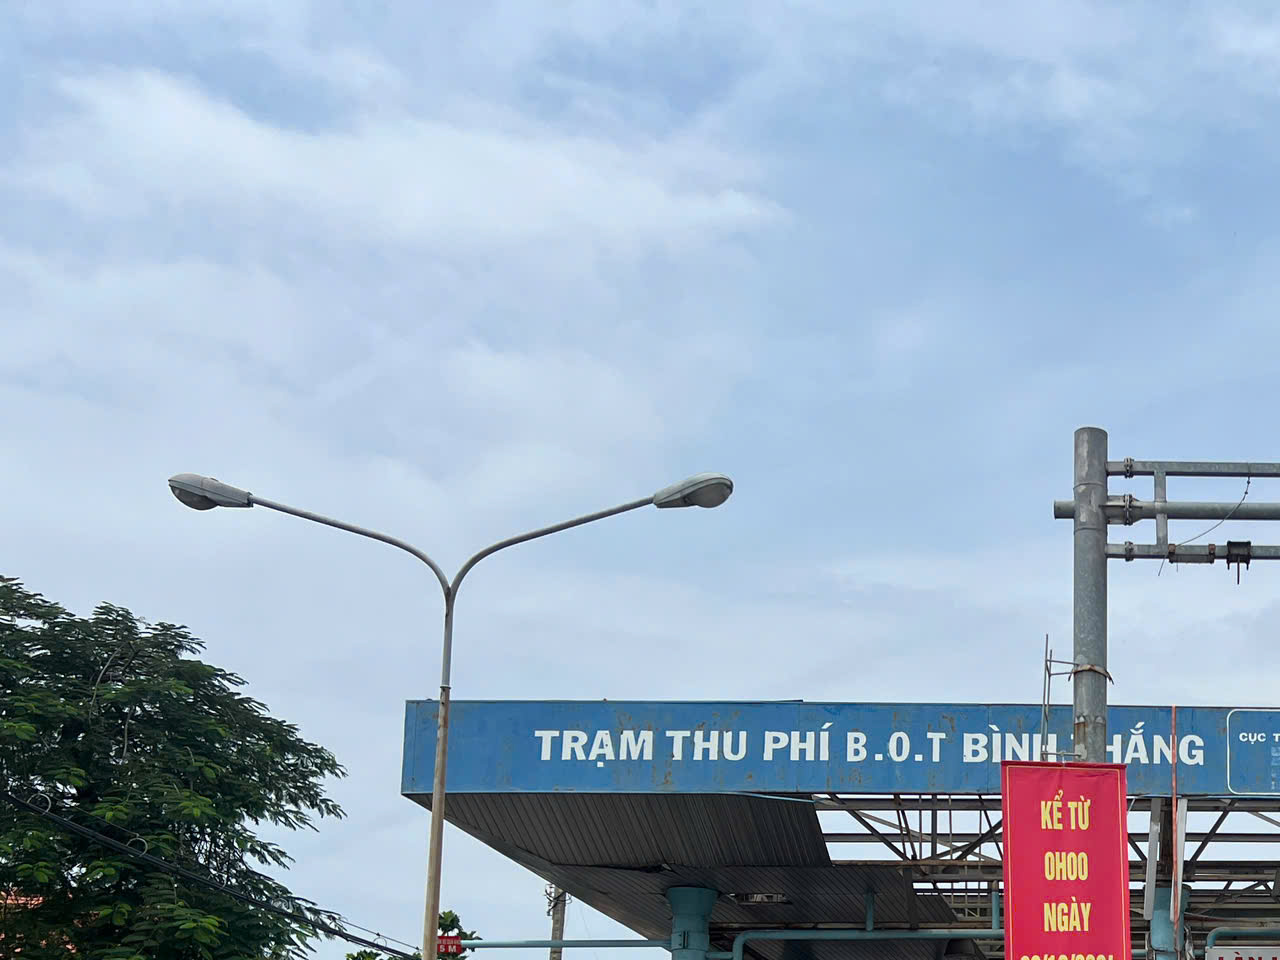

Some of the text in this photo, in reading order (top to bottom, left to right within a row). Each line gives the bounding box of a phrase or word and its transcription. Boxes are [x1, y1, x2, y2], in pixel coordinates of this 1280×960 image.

[534, 730, 654, 768] TRẠM
[665, 730, 747, 761] THU
[763, 722, 833, 761] PHÍ
[962, 724, 1057, 763] BÌNH
[1070, 721, 1205, 766] HẮNG
[1239, 732, 1266, 745] CỤC
[1041, 790, 1091, 830] KỂ TỪ
[1043, 897, 1091, 932] NGÀY
